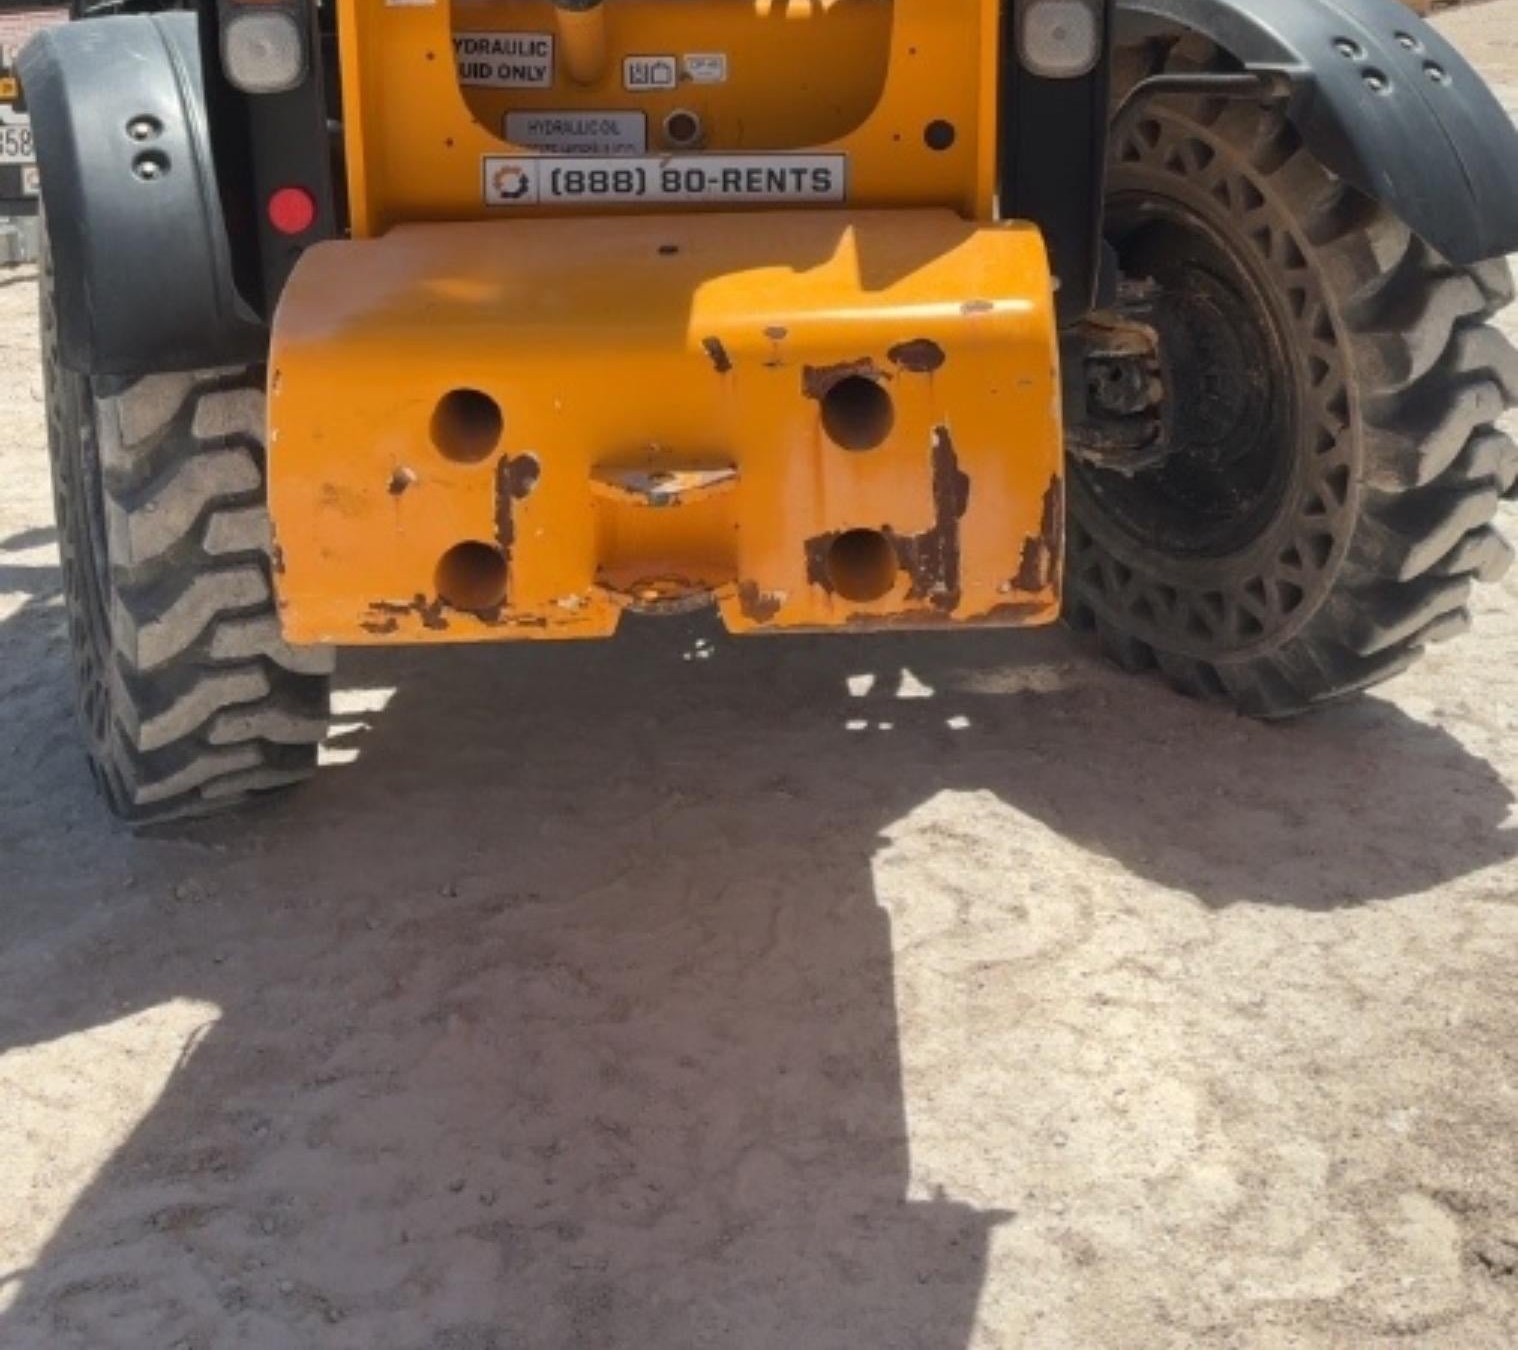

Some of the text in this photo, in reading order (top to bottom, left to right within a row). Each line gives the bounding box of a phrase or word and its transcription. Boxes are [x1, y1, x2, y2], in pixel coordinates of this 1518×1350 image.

[452, 37, 548, 58] YDRAULIC
[459, 61, 548, 82] UID ONLY
[0, 128, 34, 156] 58
[551, 167, 833, 195] (888) 80-RENTS
